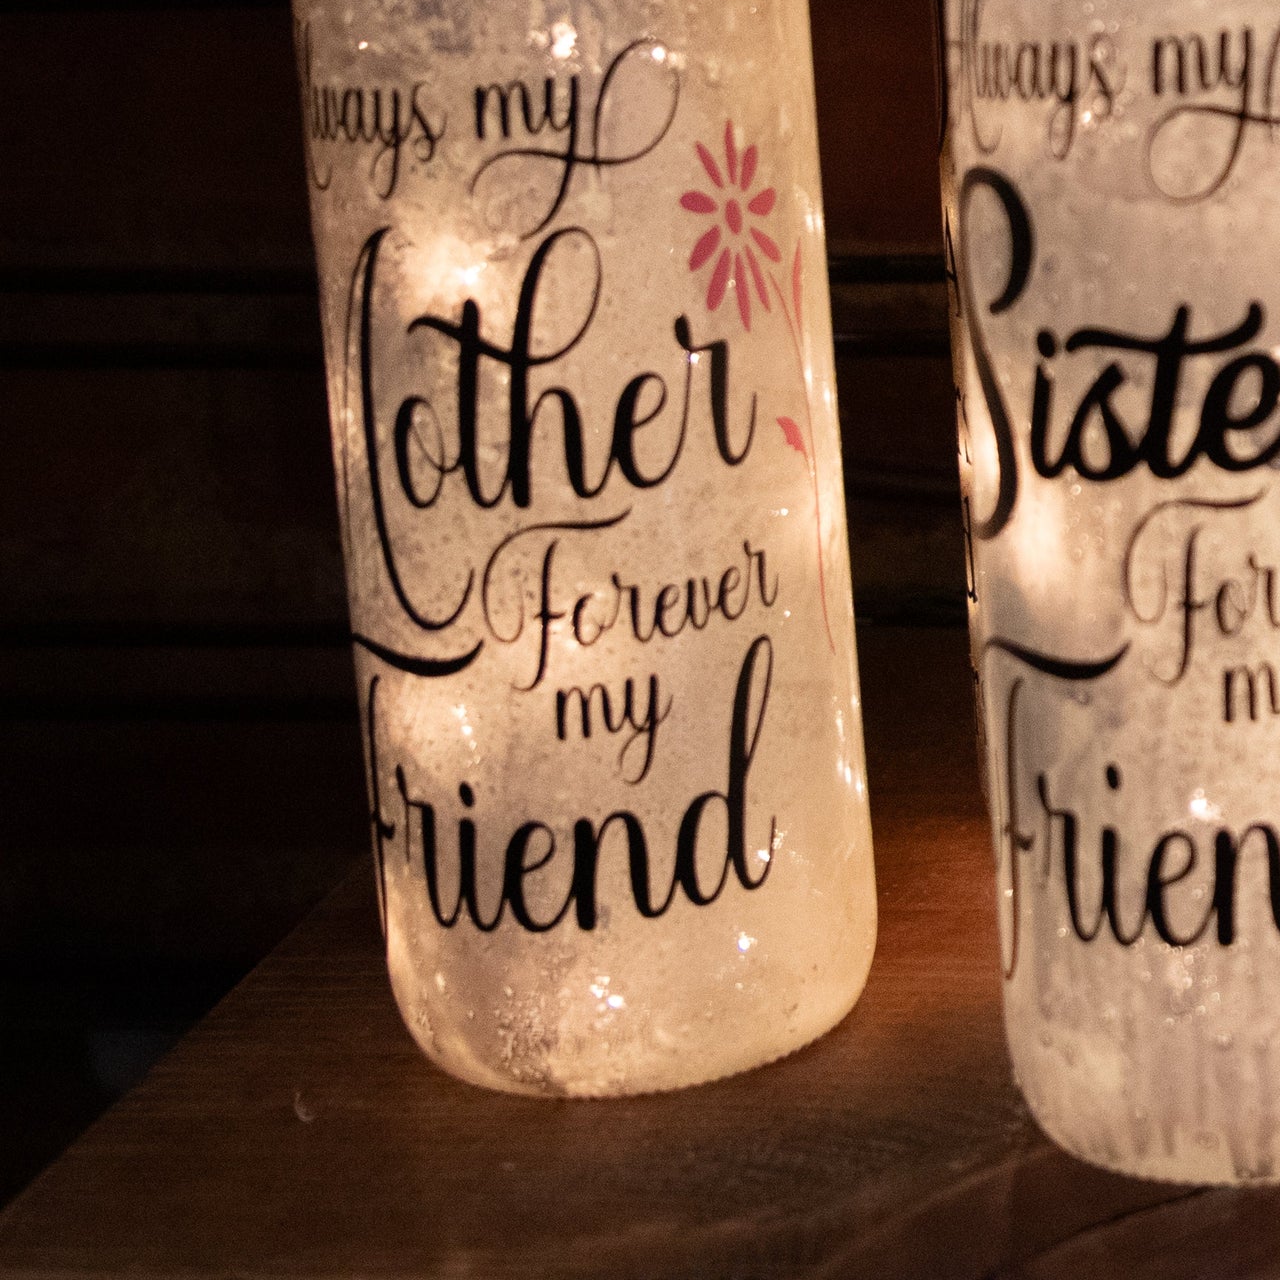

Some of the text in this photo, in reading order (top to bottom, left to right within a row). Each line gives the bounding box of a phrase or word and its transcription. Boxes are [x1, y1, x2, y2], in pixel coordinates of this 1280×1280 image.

[467, 37, 681, 240] my
[482, 506, 779, 692] Forever
[555, 674, 673, 785] my
